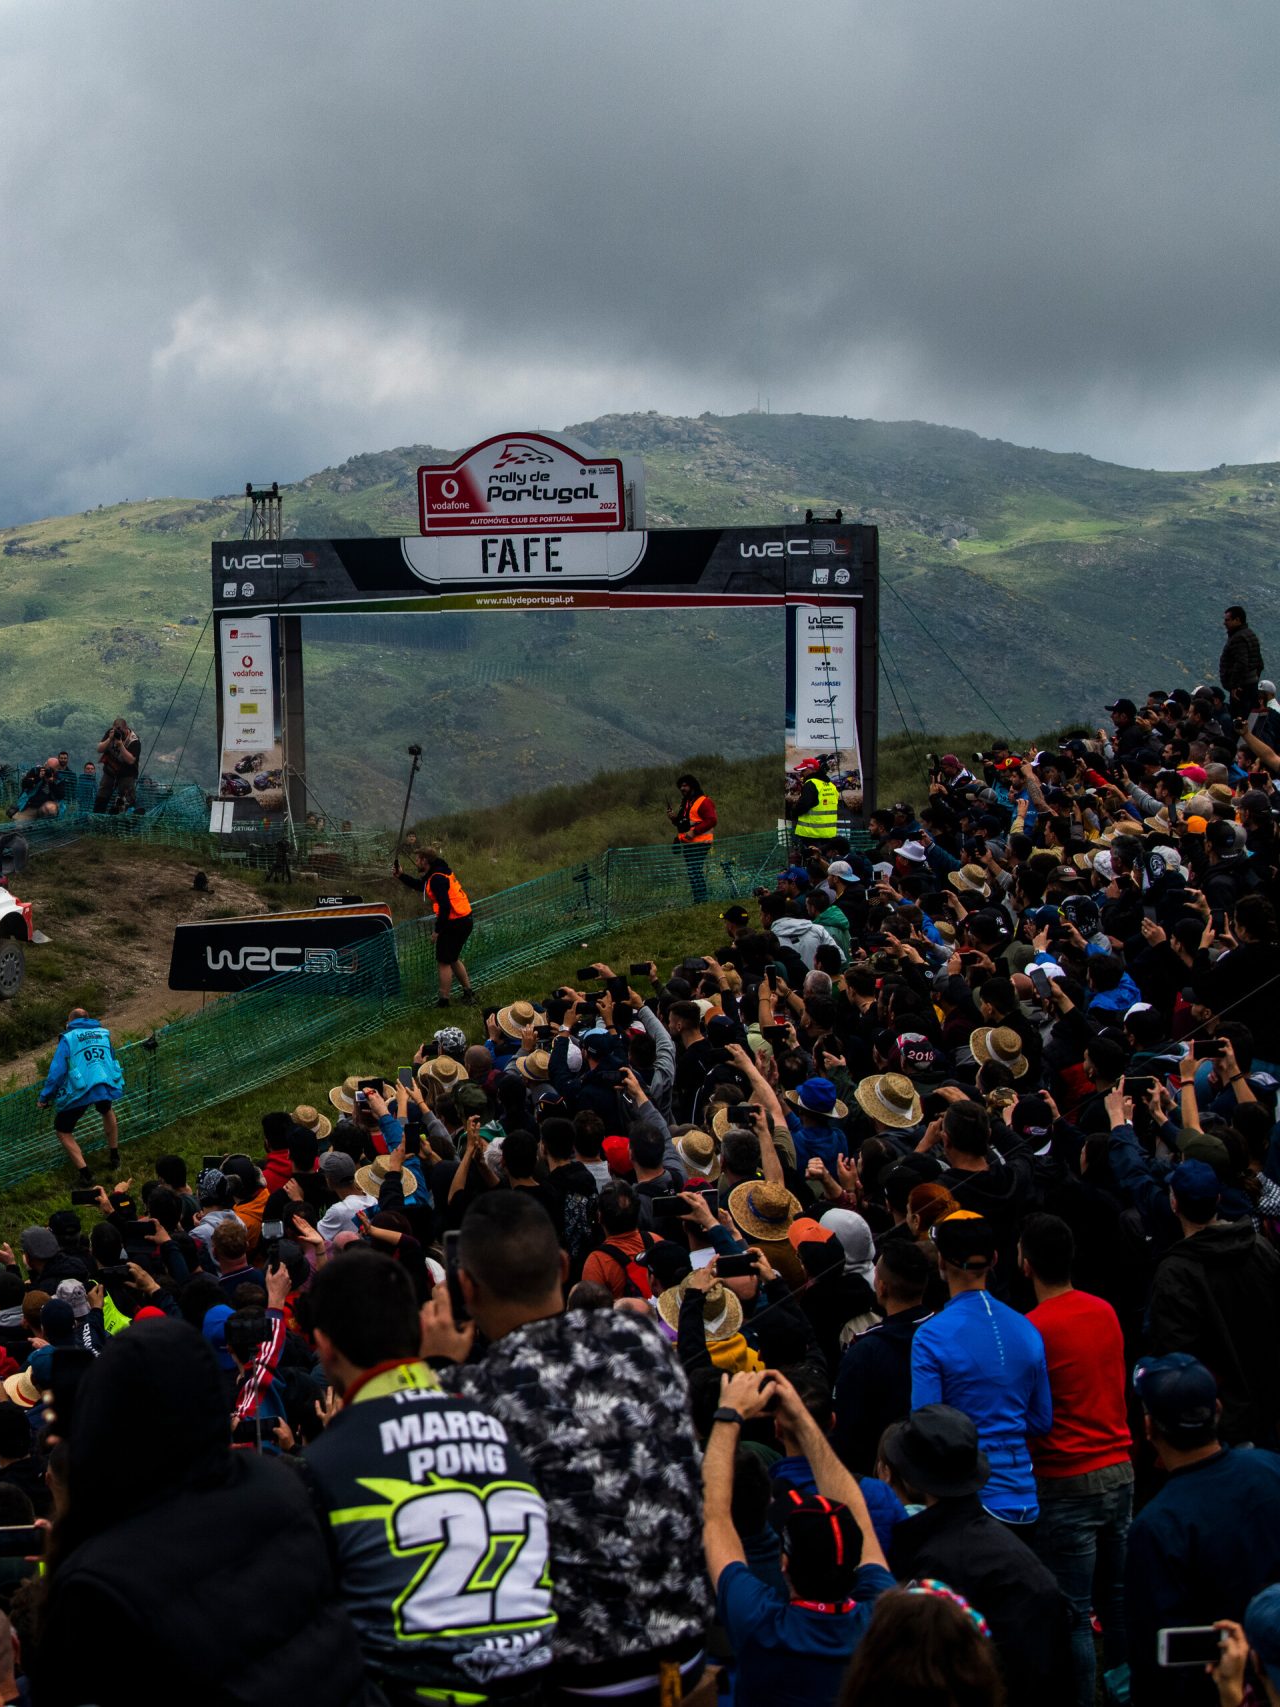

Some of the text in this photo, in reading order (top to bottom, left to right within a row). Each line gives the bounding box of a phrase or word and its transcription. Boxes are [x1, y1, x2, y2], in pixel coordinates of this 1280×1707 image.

[489, 471, 550, 486] rally de
[487, 483, 599, 504] Portugal
[432, 501, 470, 510] vodafone
[600, 502, 617, 510] 2022
[470, 516, 510, 525] AUTOMÓVEL
[481, 537, 563, 574] FAFE
[475, 595, 575, 606] www.rallydeportugal.pt
[232, 669, 264, 677] vodafone
[319, 897, 344, 905] WRC
[83, 1047, 105, 1061] 052
[408, 1444, 508, 1483] PONG
[393, 1488, 553, 1634] 22
